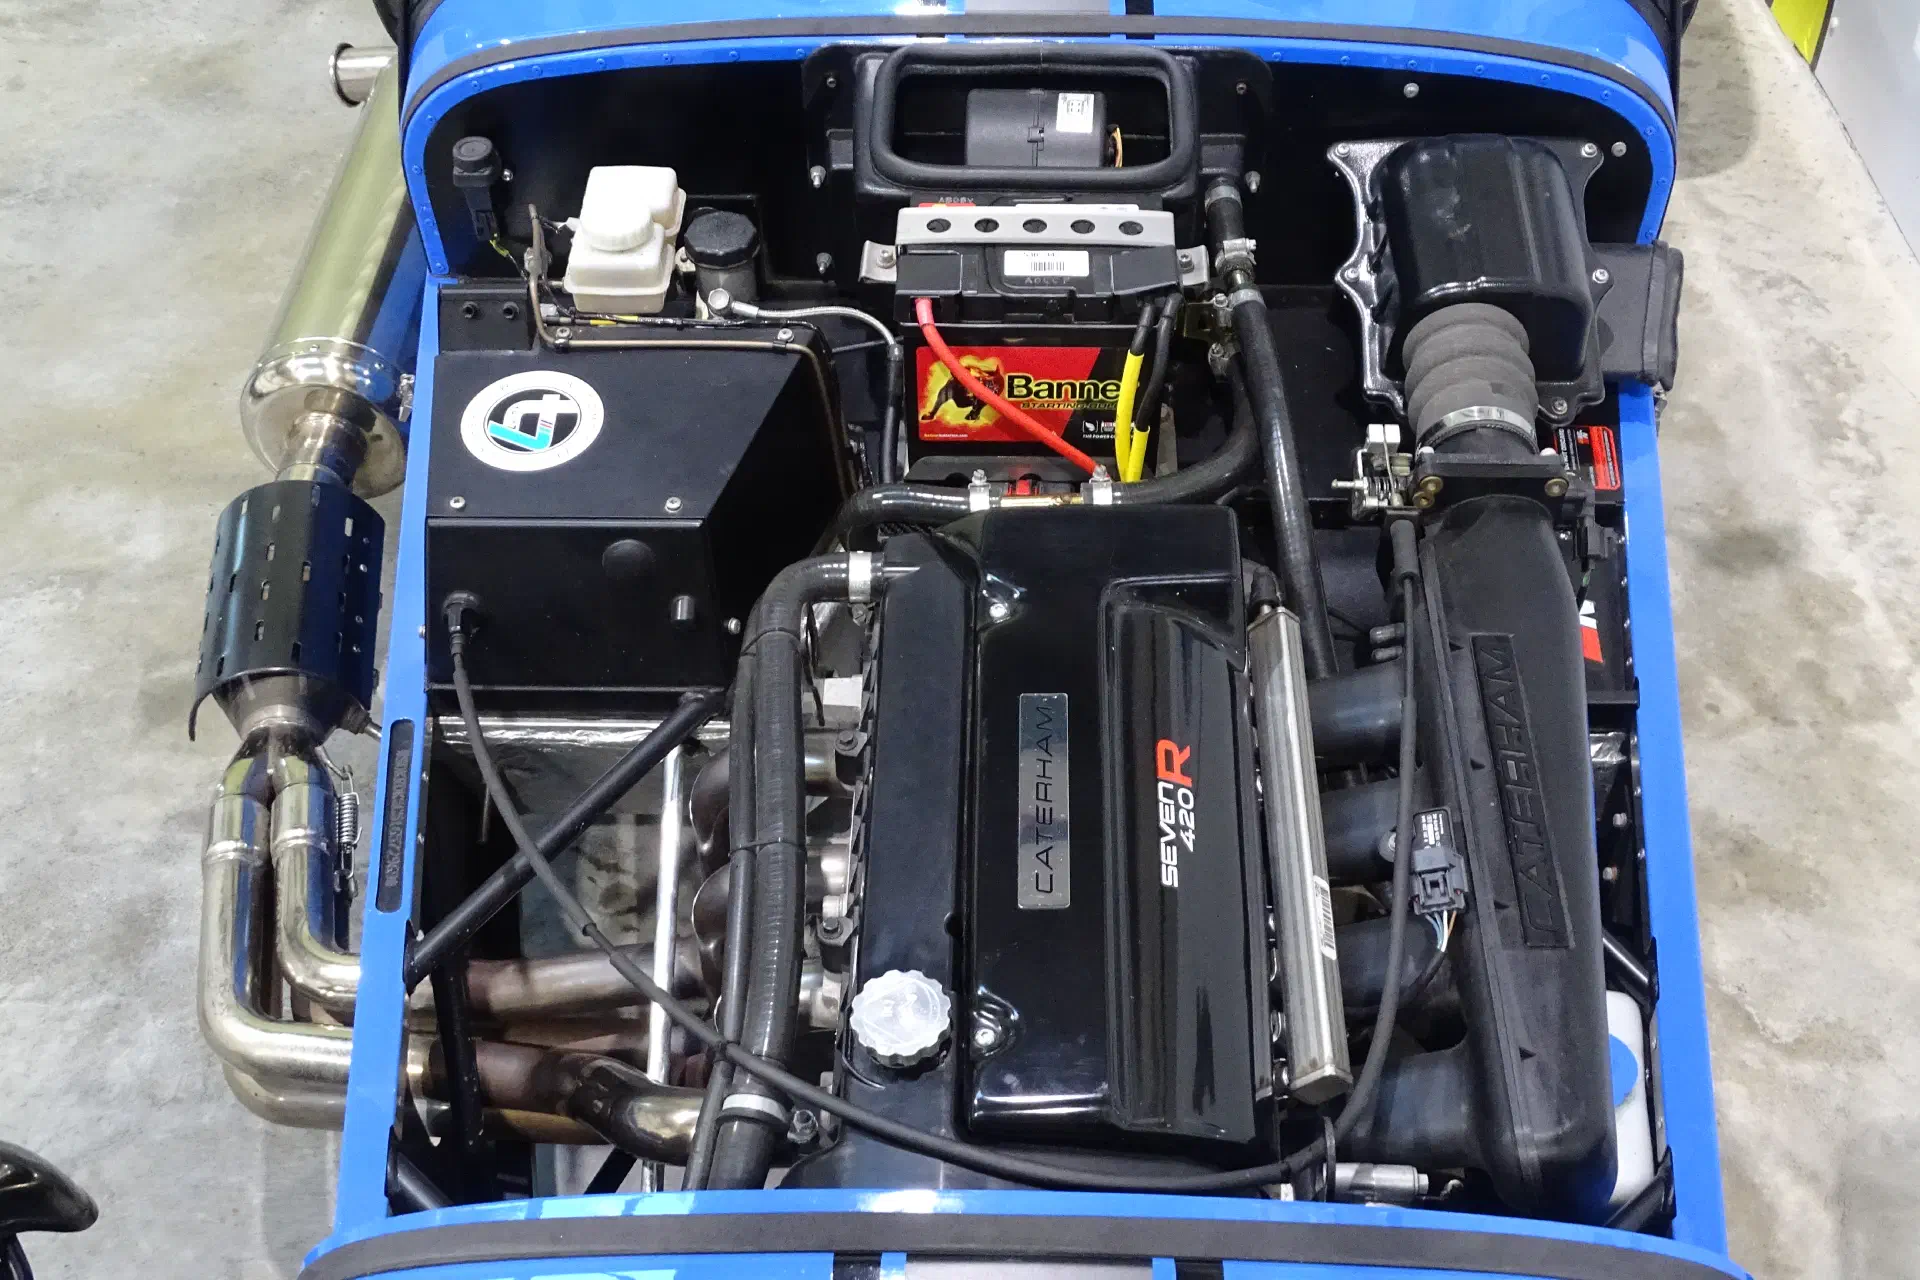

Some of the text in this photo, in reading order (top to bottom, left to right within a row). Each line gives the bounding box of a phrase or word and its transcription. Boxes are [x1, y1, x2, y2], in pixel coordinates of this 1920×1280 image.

[1006, 373, 1121, 400] Banne
[1035, 705, 1053, 894] CATERHAM
[1177, 787, 1196, 852] 420
[1479, 648, 1559, 933] CATERHAM
